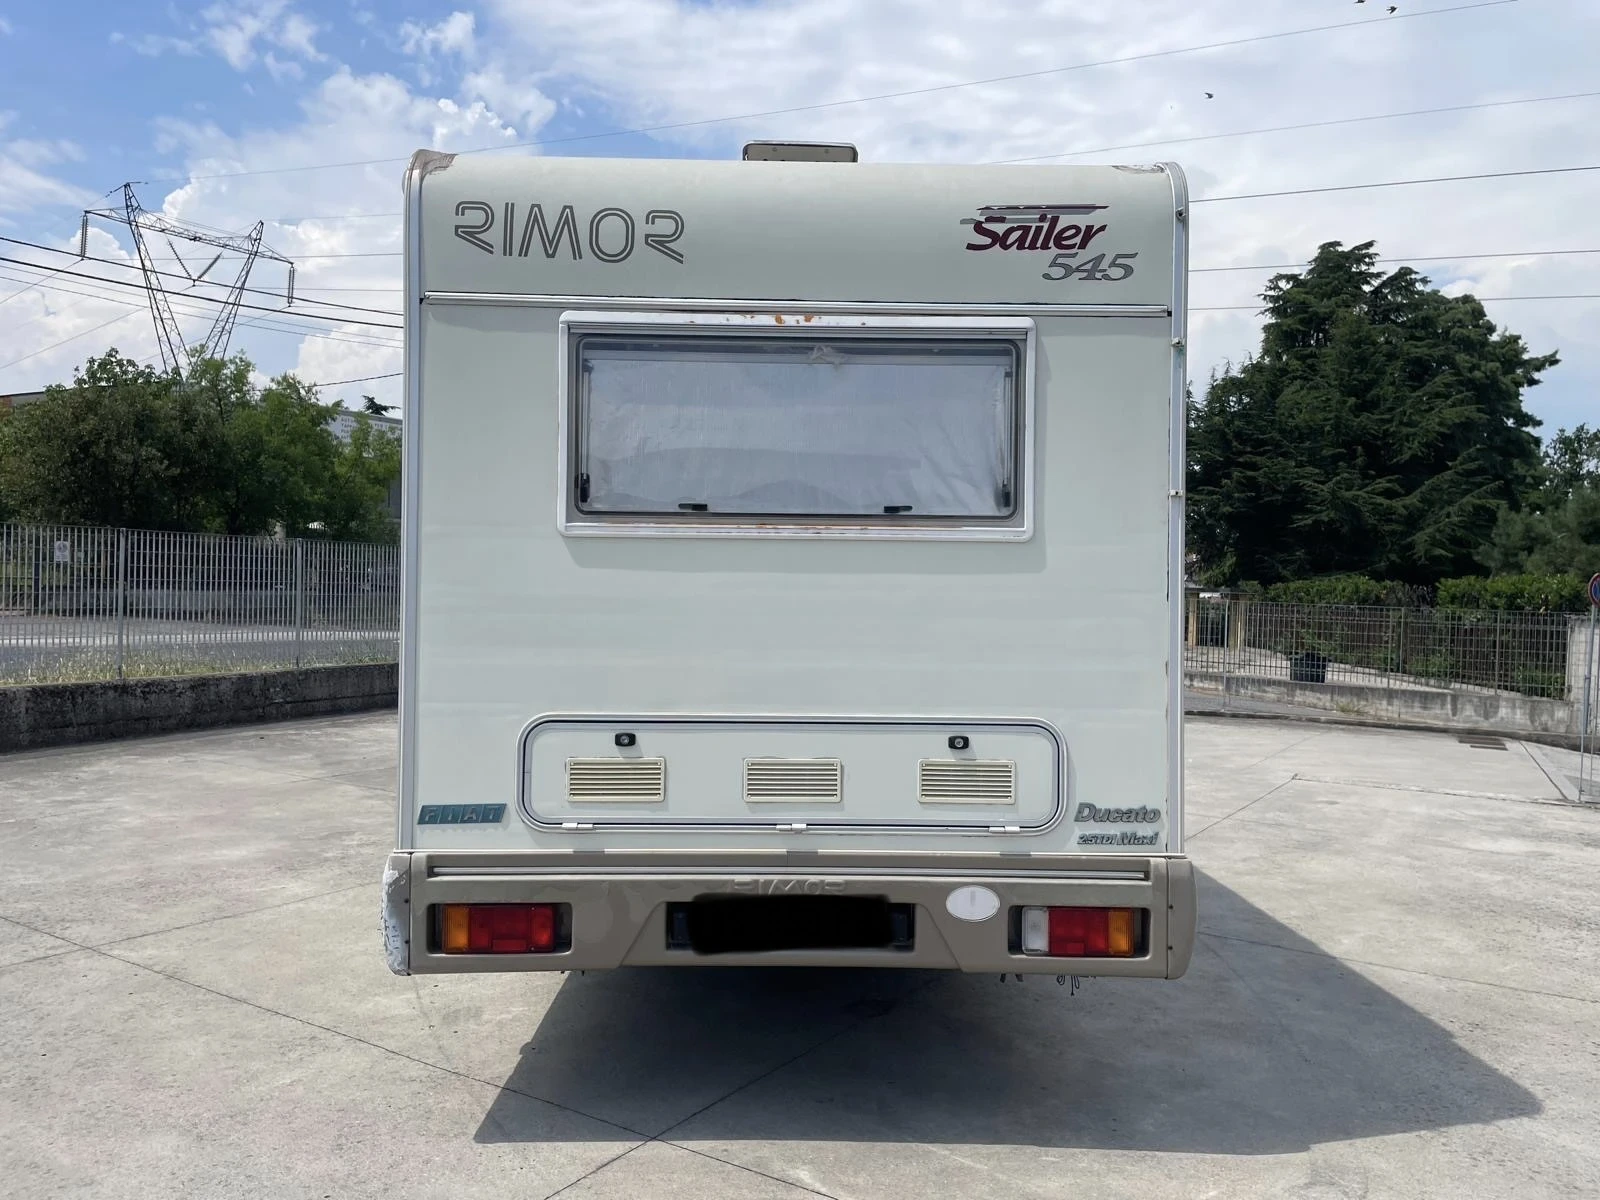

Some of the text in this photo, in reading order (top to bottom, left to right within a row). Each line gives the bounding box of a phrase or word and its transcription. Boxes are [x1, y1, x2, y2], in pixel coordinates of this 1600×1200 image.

[454, 200, 685, 264] RIMOR
[965, 213, 1108, 251] Sailer
[1041, 252, 1139, 281] 545
[421, 804, 502, 822] FIAT
[1074, 802, 1160, 823] Ducato
[1116, 831, 1159, 846] Maxi
